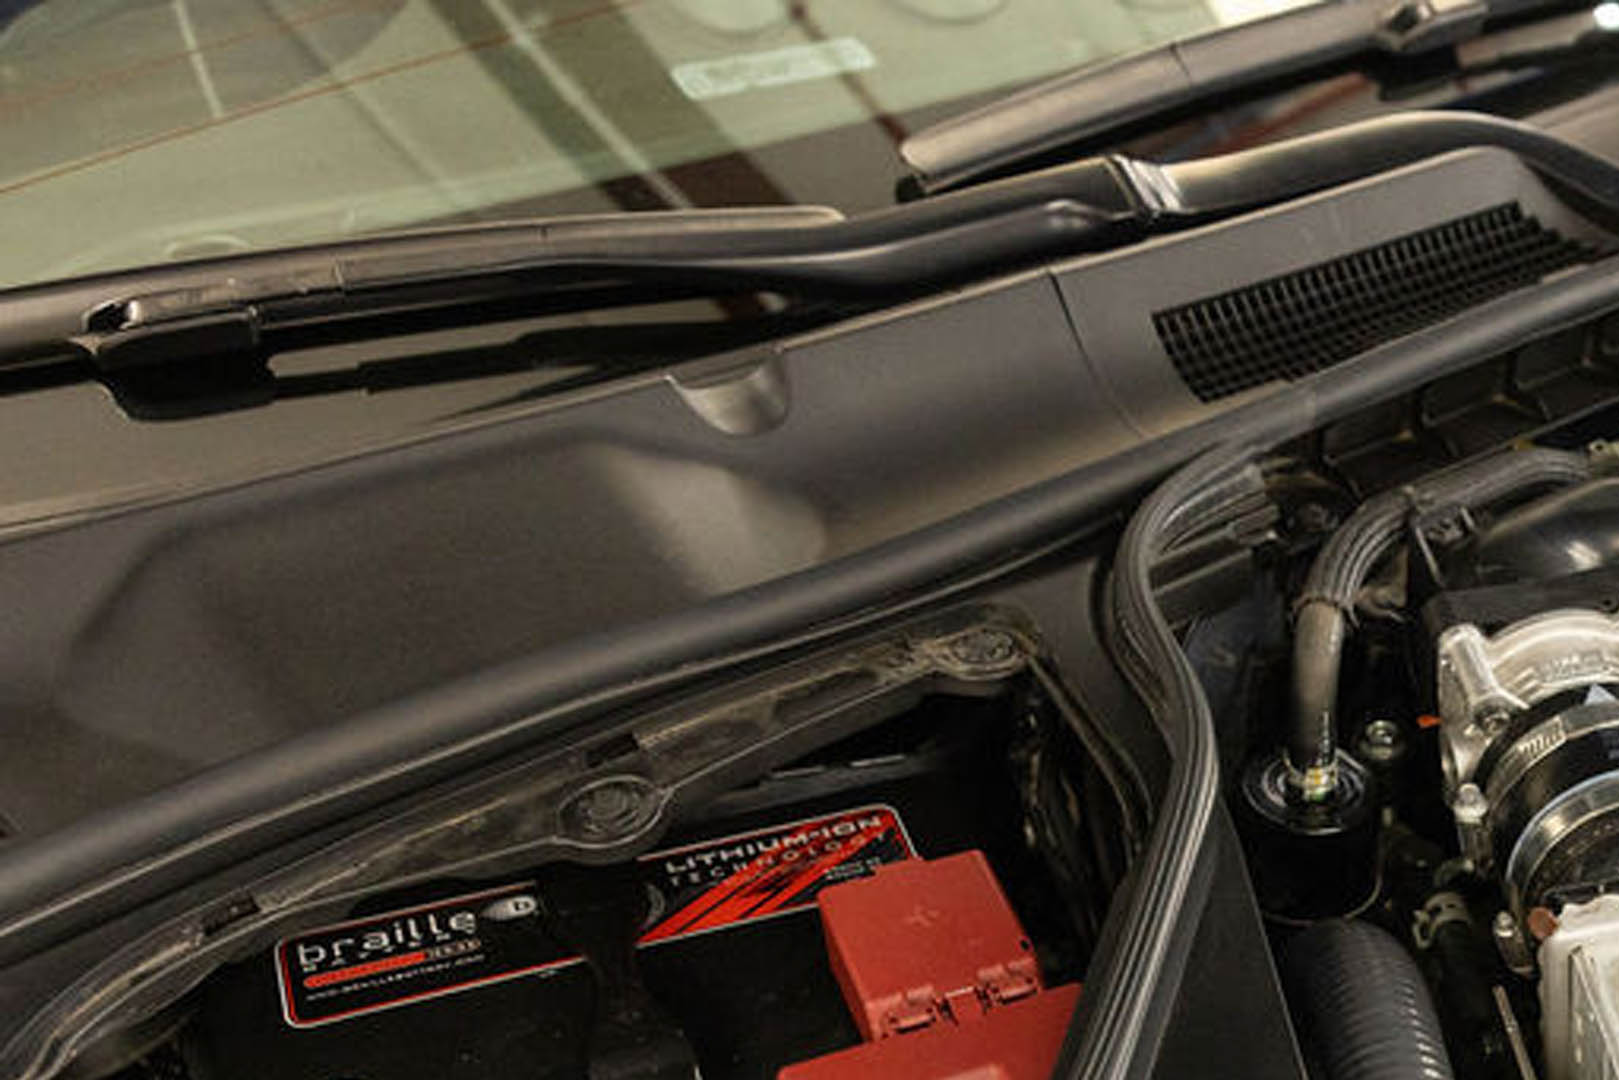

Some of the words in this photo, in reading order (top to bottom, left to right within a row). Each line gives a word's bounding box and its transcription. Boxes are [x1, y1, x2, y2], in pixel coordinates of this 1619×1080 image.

[665, 815, 882, 874] LITHIUM-ION
[667, 834, 886, 887] TECHNOLOGY
[298, 912, 478, 964] braille
